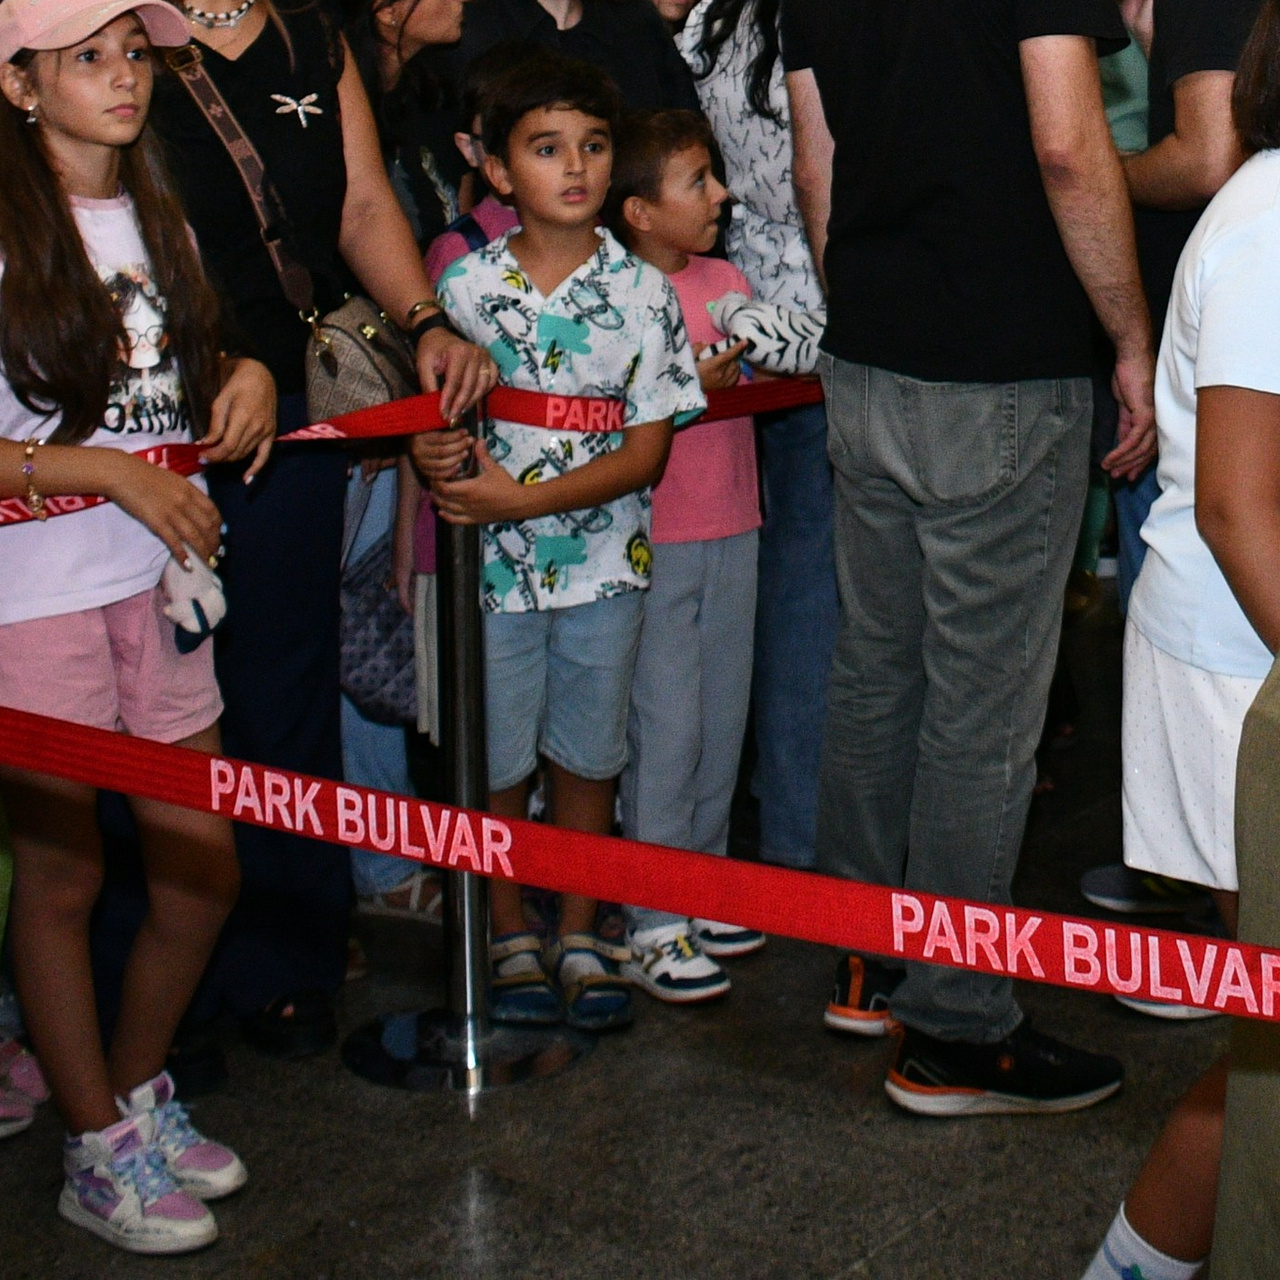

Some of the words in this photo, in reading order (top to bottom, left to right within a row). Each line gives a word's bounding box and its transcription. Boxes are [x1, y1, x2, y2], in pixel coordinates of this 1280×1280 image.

[546, 396, 624, 431] PARK
[210, 758, 324, 836] PARK
[336, 786, 515, 878] BULVAR
[892, 892, 1046, 979] PARK
